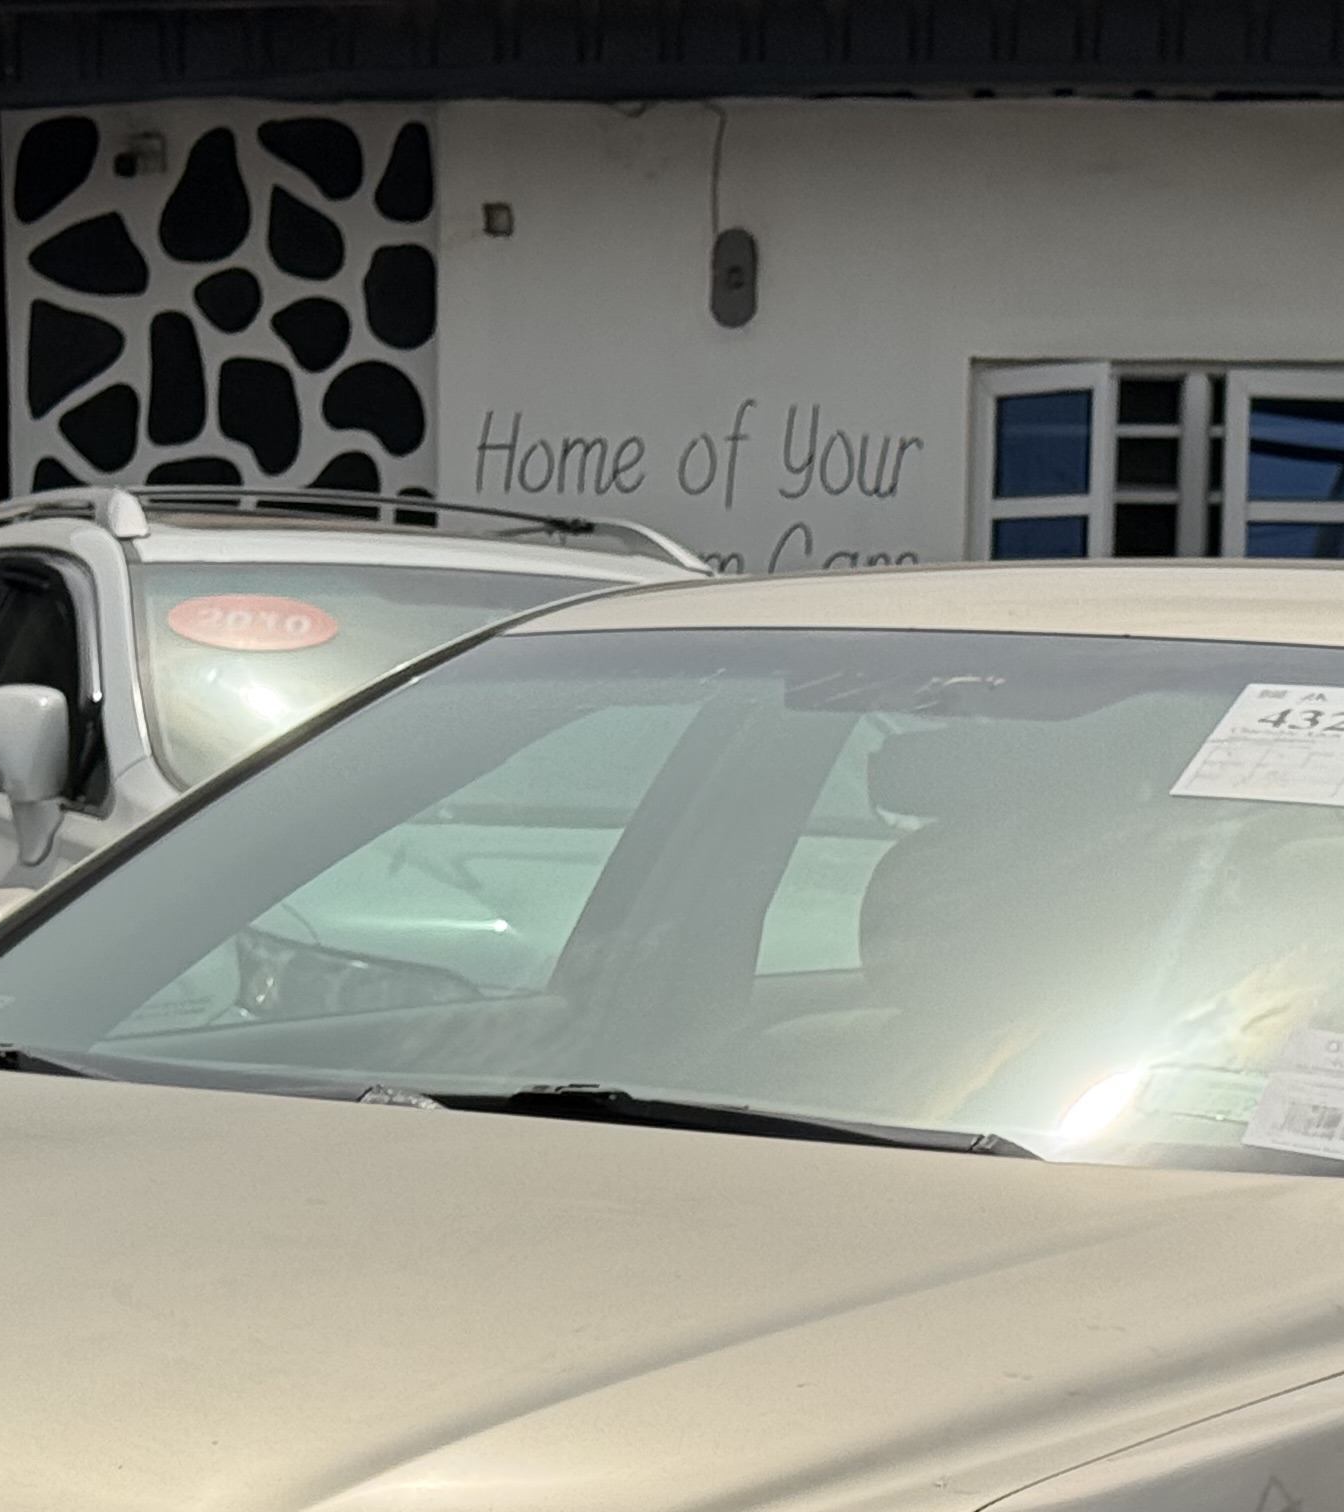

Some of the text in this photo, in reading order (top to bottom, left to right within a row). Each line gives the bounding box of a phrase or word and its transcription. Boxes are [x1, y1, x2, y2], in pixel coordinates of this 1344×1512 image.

[476, 399, 924, 509] Home of Your
